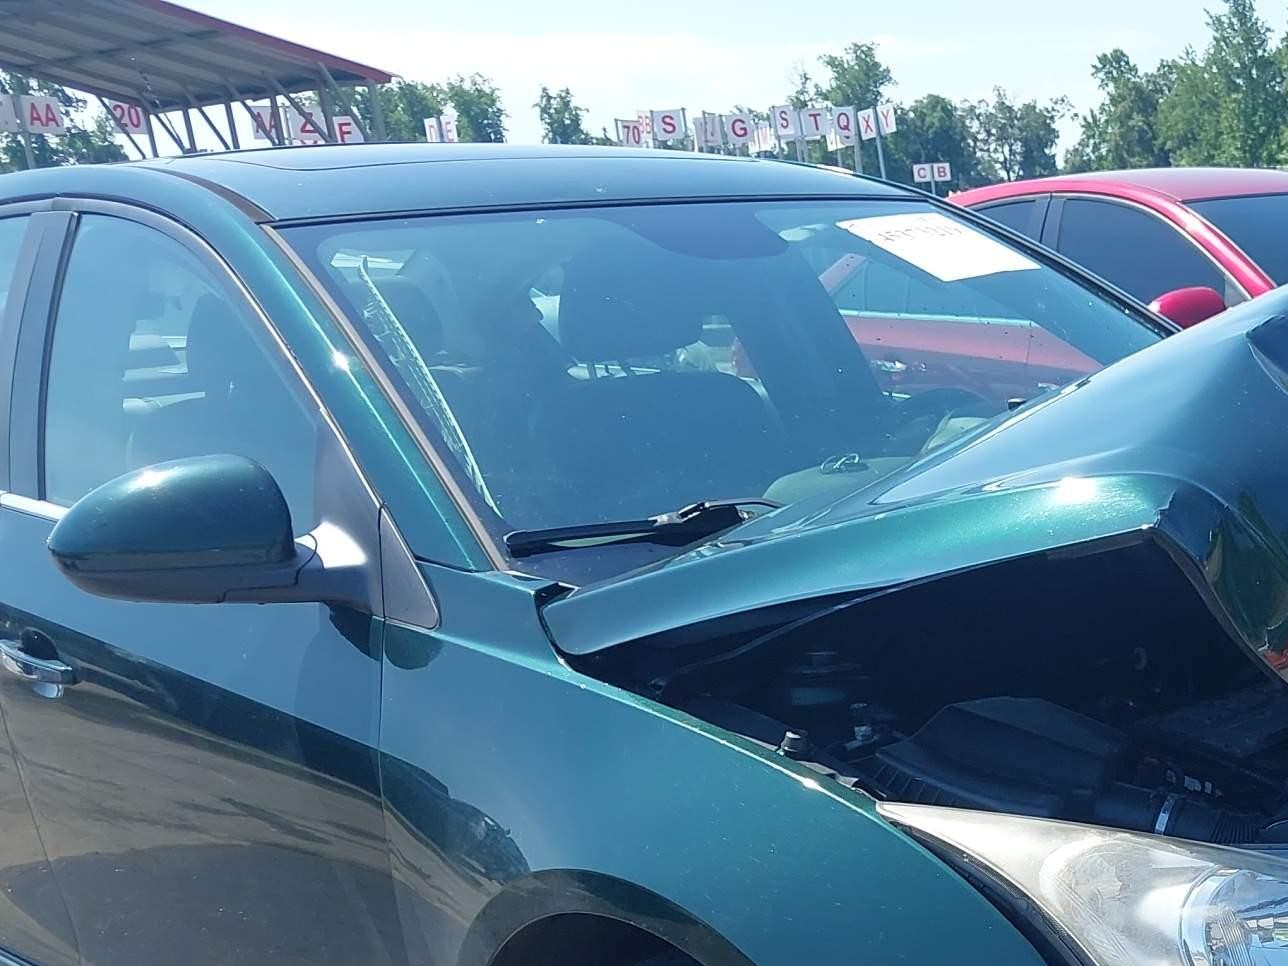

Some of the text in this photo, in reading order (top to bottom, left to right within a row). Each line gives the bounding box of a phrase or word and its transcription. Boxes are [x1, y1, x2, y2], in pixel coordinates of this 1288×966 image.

[29, 102, 60, 127] AA
[112, 103, 141, 129] 20
[661, 114, 677, 134] S
[779, 110, 789, 129] S
[808, 112, 821, 131] T
[837, 112, 851, 131] Q
[862, 114, 874, 134] X
[881, 109, 890, 128] Y
[337, 122, 352, 144] F
[622, 125, 641, 144] 70
[731, 118, 748, 138] G
[917, 167, 927, 179] C
[937, 166, 947, 178] B
